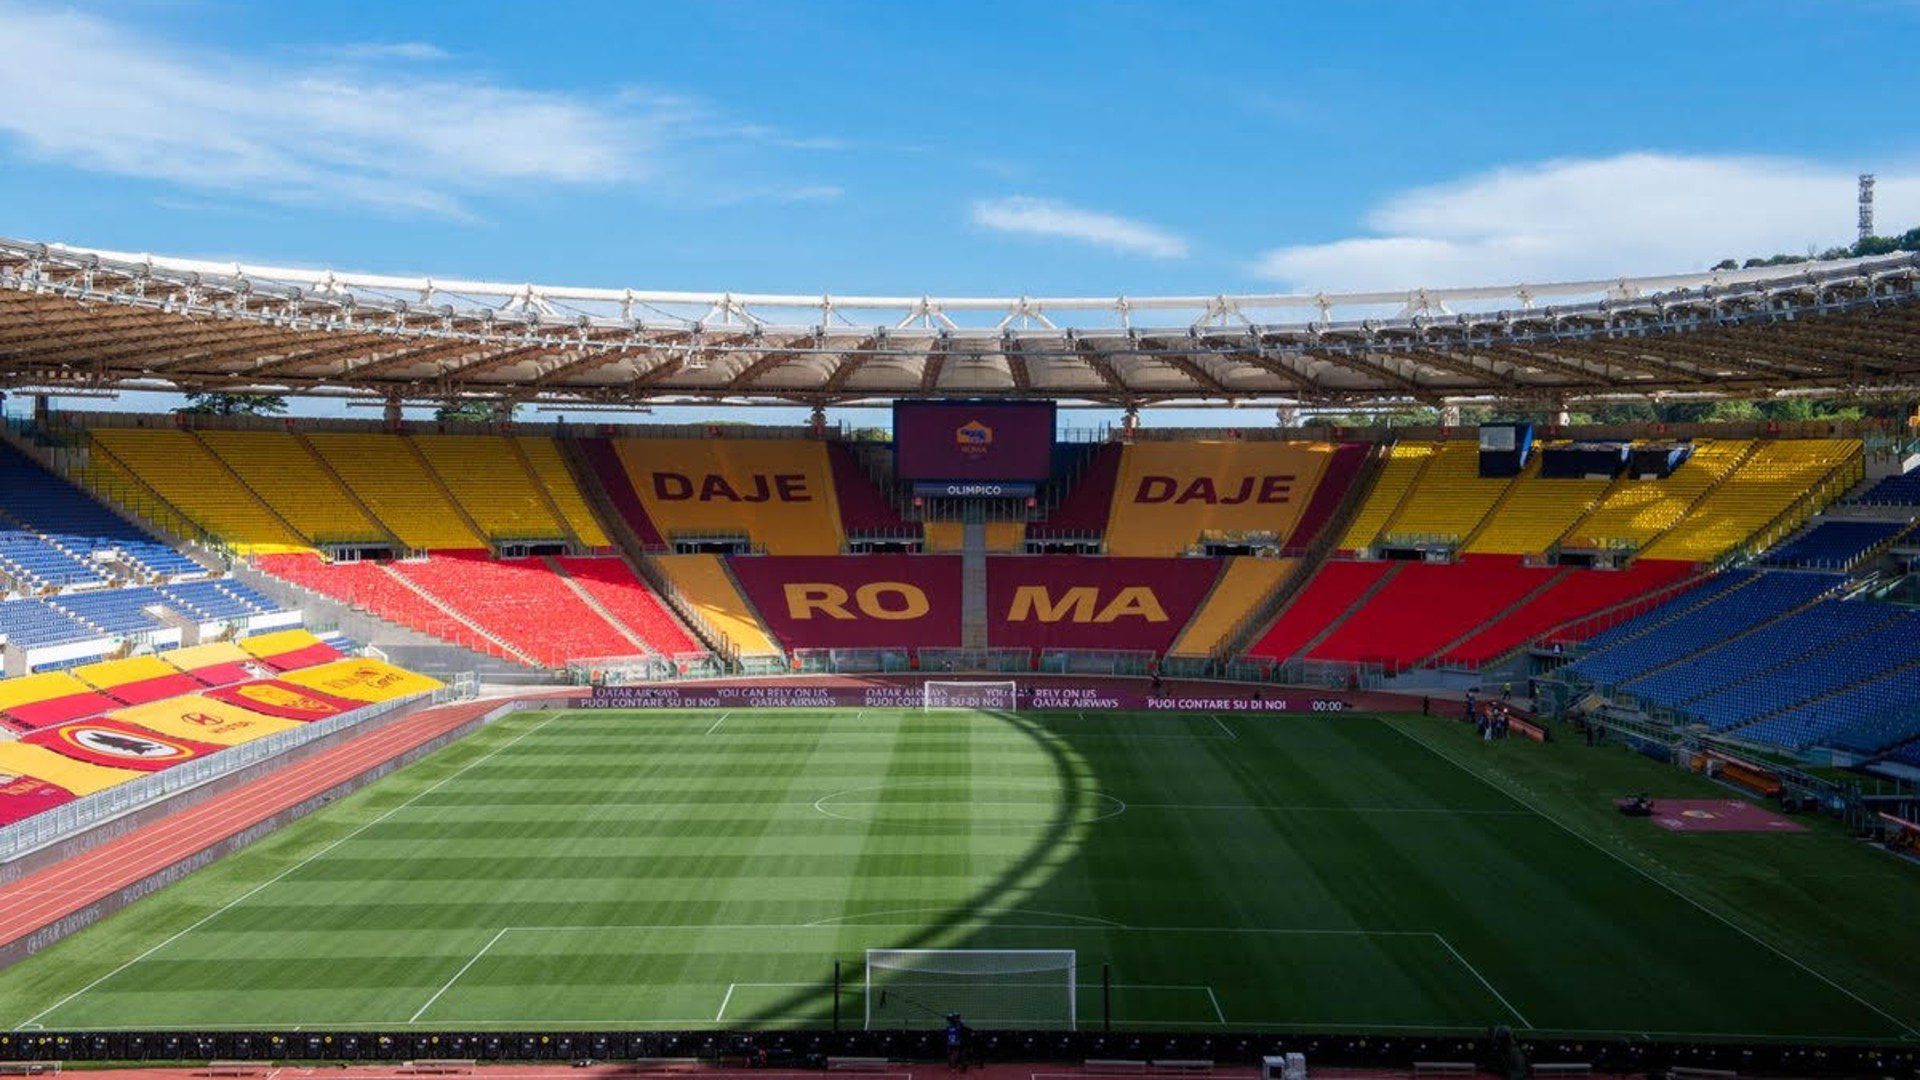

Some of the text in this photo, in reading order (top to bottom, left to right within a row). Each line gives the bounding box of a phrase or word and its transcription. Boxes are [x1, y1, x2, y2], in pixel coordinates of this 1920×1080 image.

[652, 472, 812, 502] DAJE
[947, 485, 1001, 495] OLIMPICO
[1134, 475, 1296, 505] DAJE
[783, 582, 930, 620] RO
[1007, 586, 1169, 623] MA
[596, 688, 632, 698] QATAR
[717, 688, 828, 697] YOU CAN RELY ON US
[866, 688, 901, 697] QATAR
[1035, 689, 1060, 697] RELY
[1063, 689, 1079, 697] ON
[1082, 689, 1097, 697] US
[581, 698, 720, 707] PUOI CONTARE SU DI NOI
[750, 698, 836, 707] QATAR AIRWAYS
[866, 697, 893, 706] PUOI
[951, 697, 965, 706] SU
[982, 697, 1003, 706] NOI
[1033, 698, 1119, 708] QATAR AIRWAYS
[1148, 699, 1286, 710] PUOI CONTARE SU DI NOI
[1312, 701, 1342, 711] 00:00
